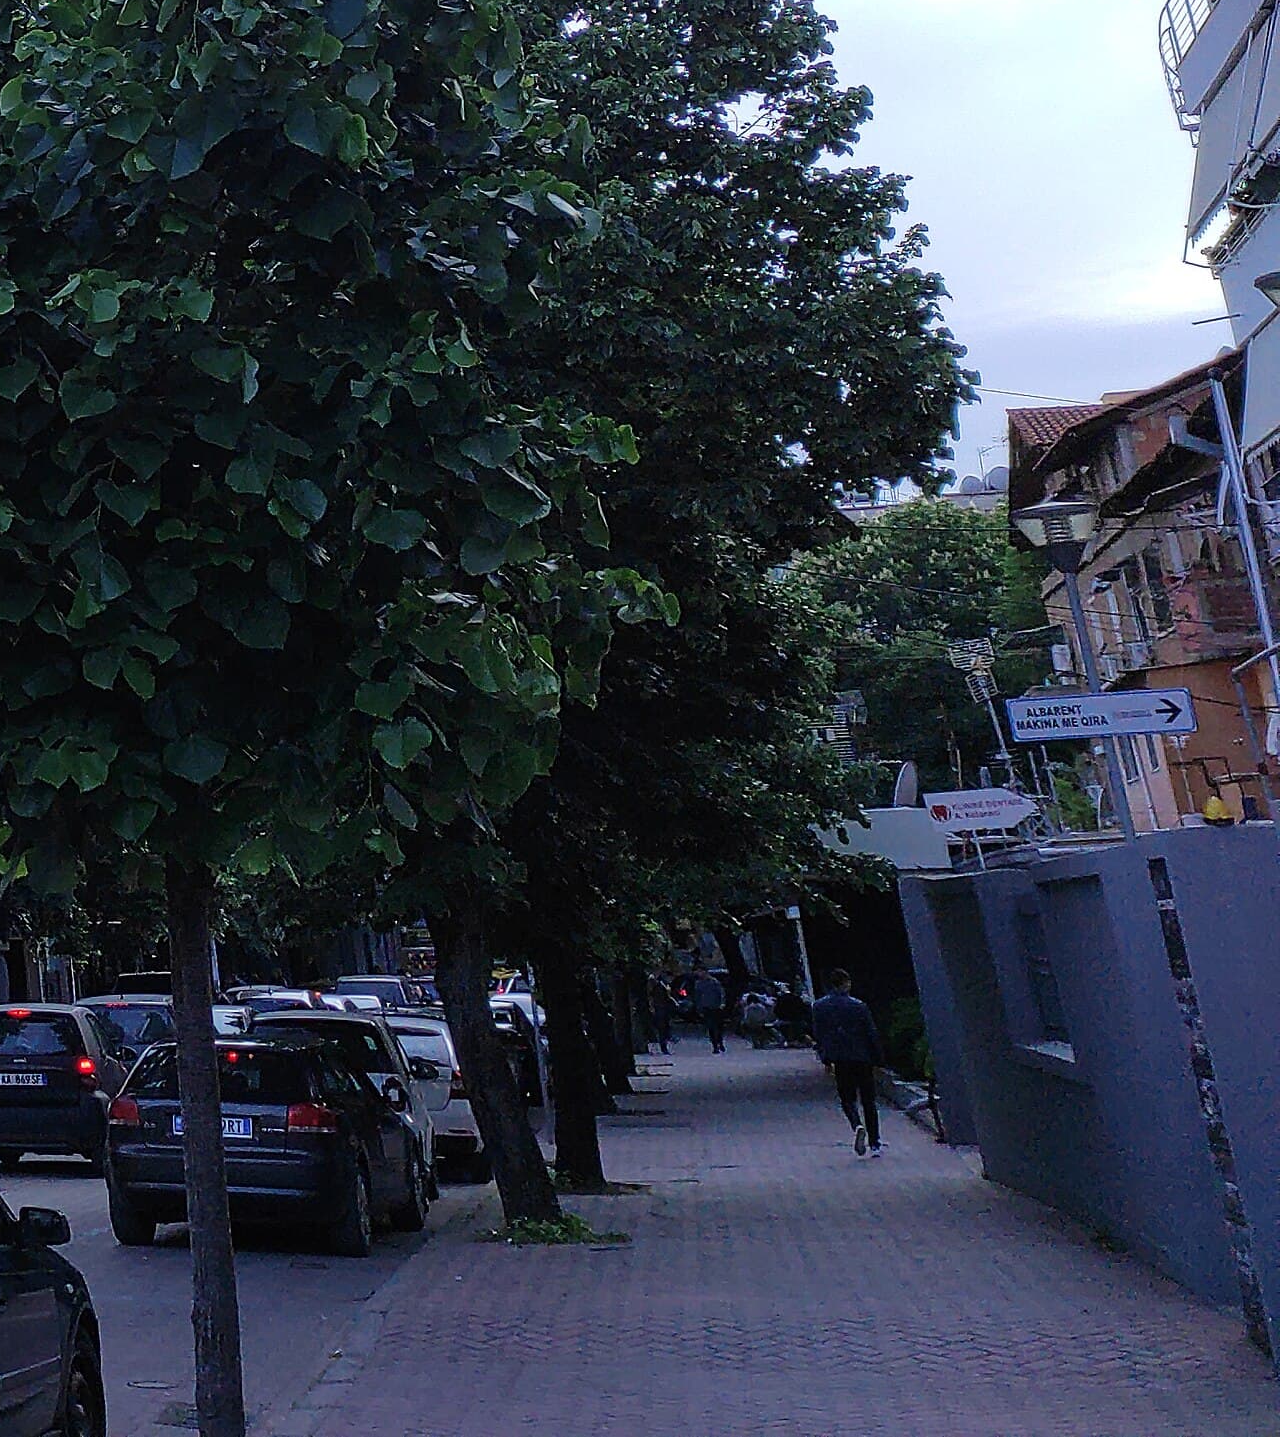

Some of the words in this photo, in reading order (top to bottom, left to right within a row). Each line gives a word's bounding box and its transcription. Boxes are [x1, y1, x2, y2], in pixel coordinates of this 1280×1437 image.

[1016, 719, 1059, 731] MAKINA
[1062, 718, 1078, 728] ME
[1081, 715, 1109, 727] QIRA
